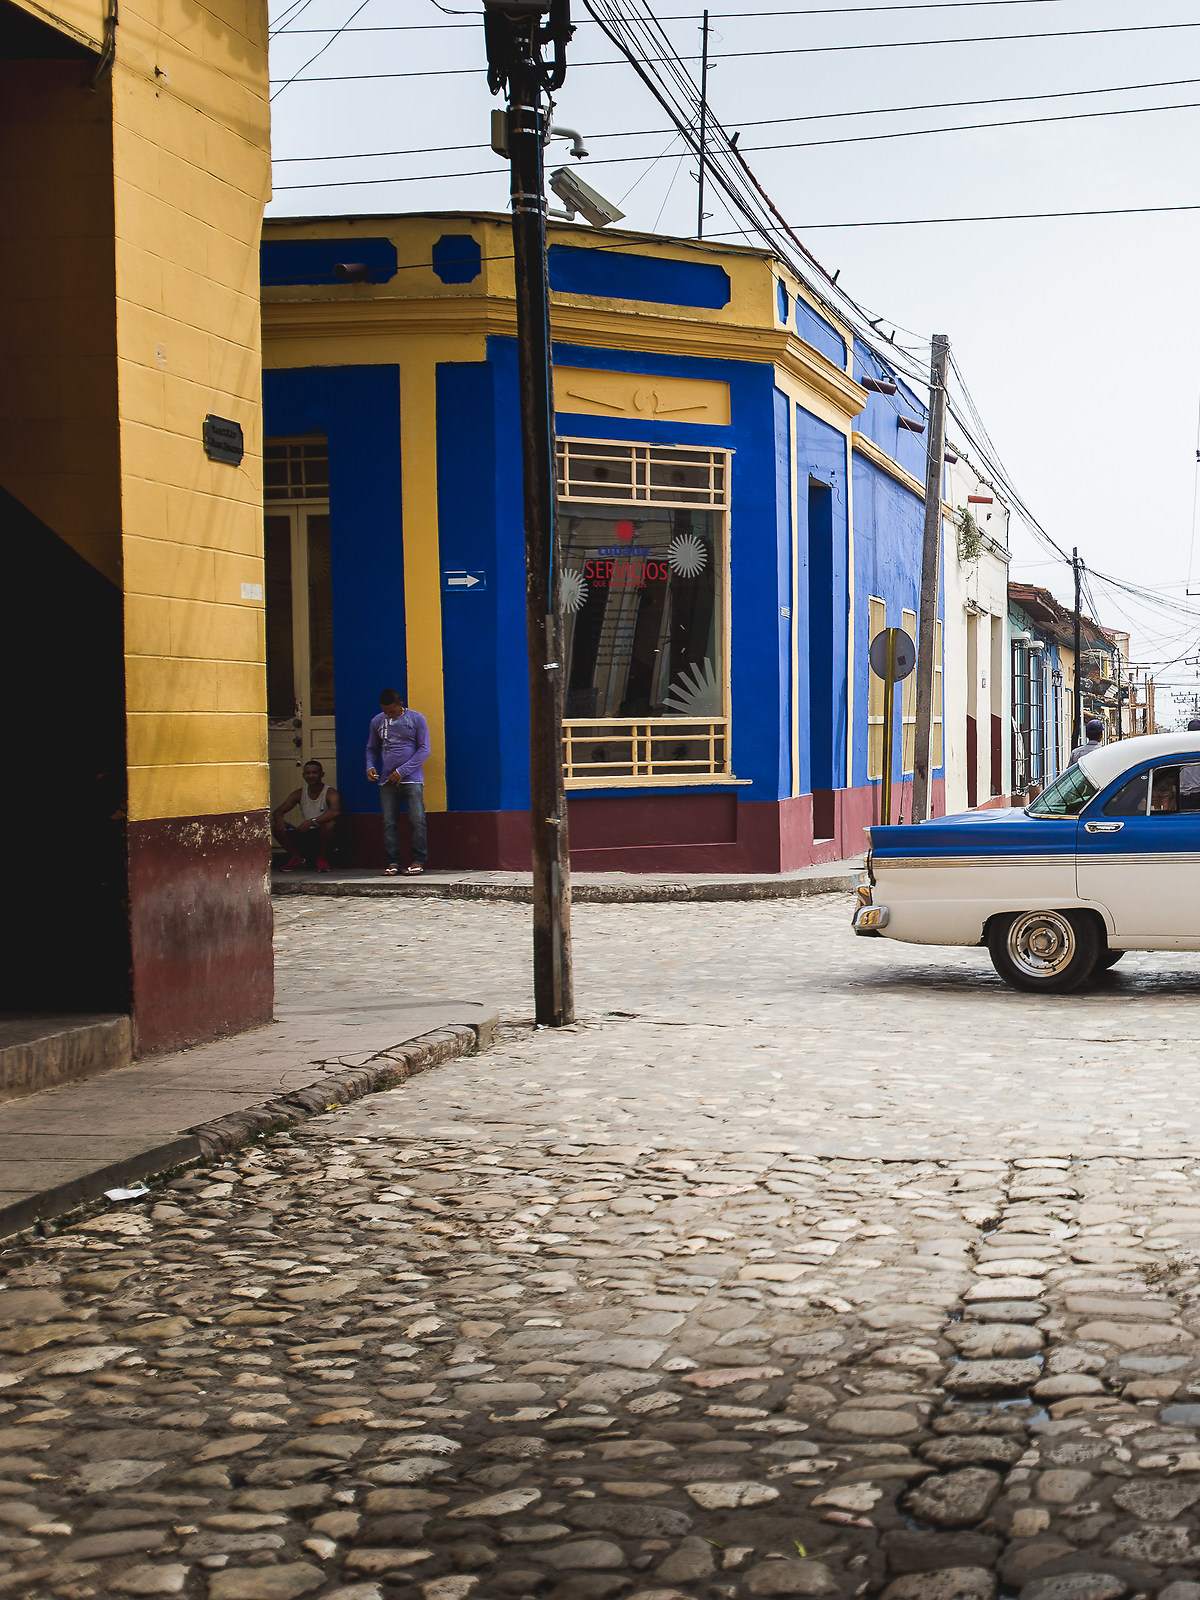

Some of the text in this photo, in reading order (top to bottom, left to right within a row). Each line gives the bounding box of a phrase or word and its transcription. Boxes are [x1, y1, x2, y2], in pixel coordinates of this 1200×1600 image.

[598, 544, 651, 556] cubatur
[585, 561, 668, 580] SERVICIOS
[593, 580, 607, 588] QUE
